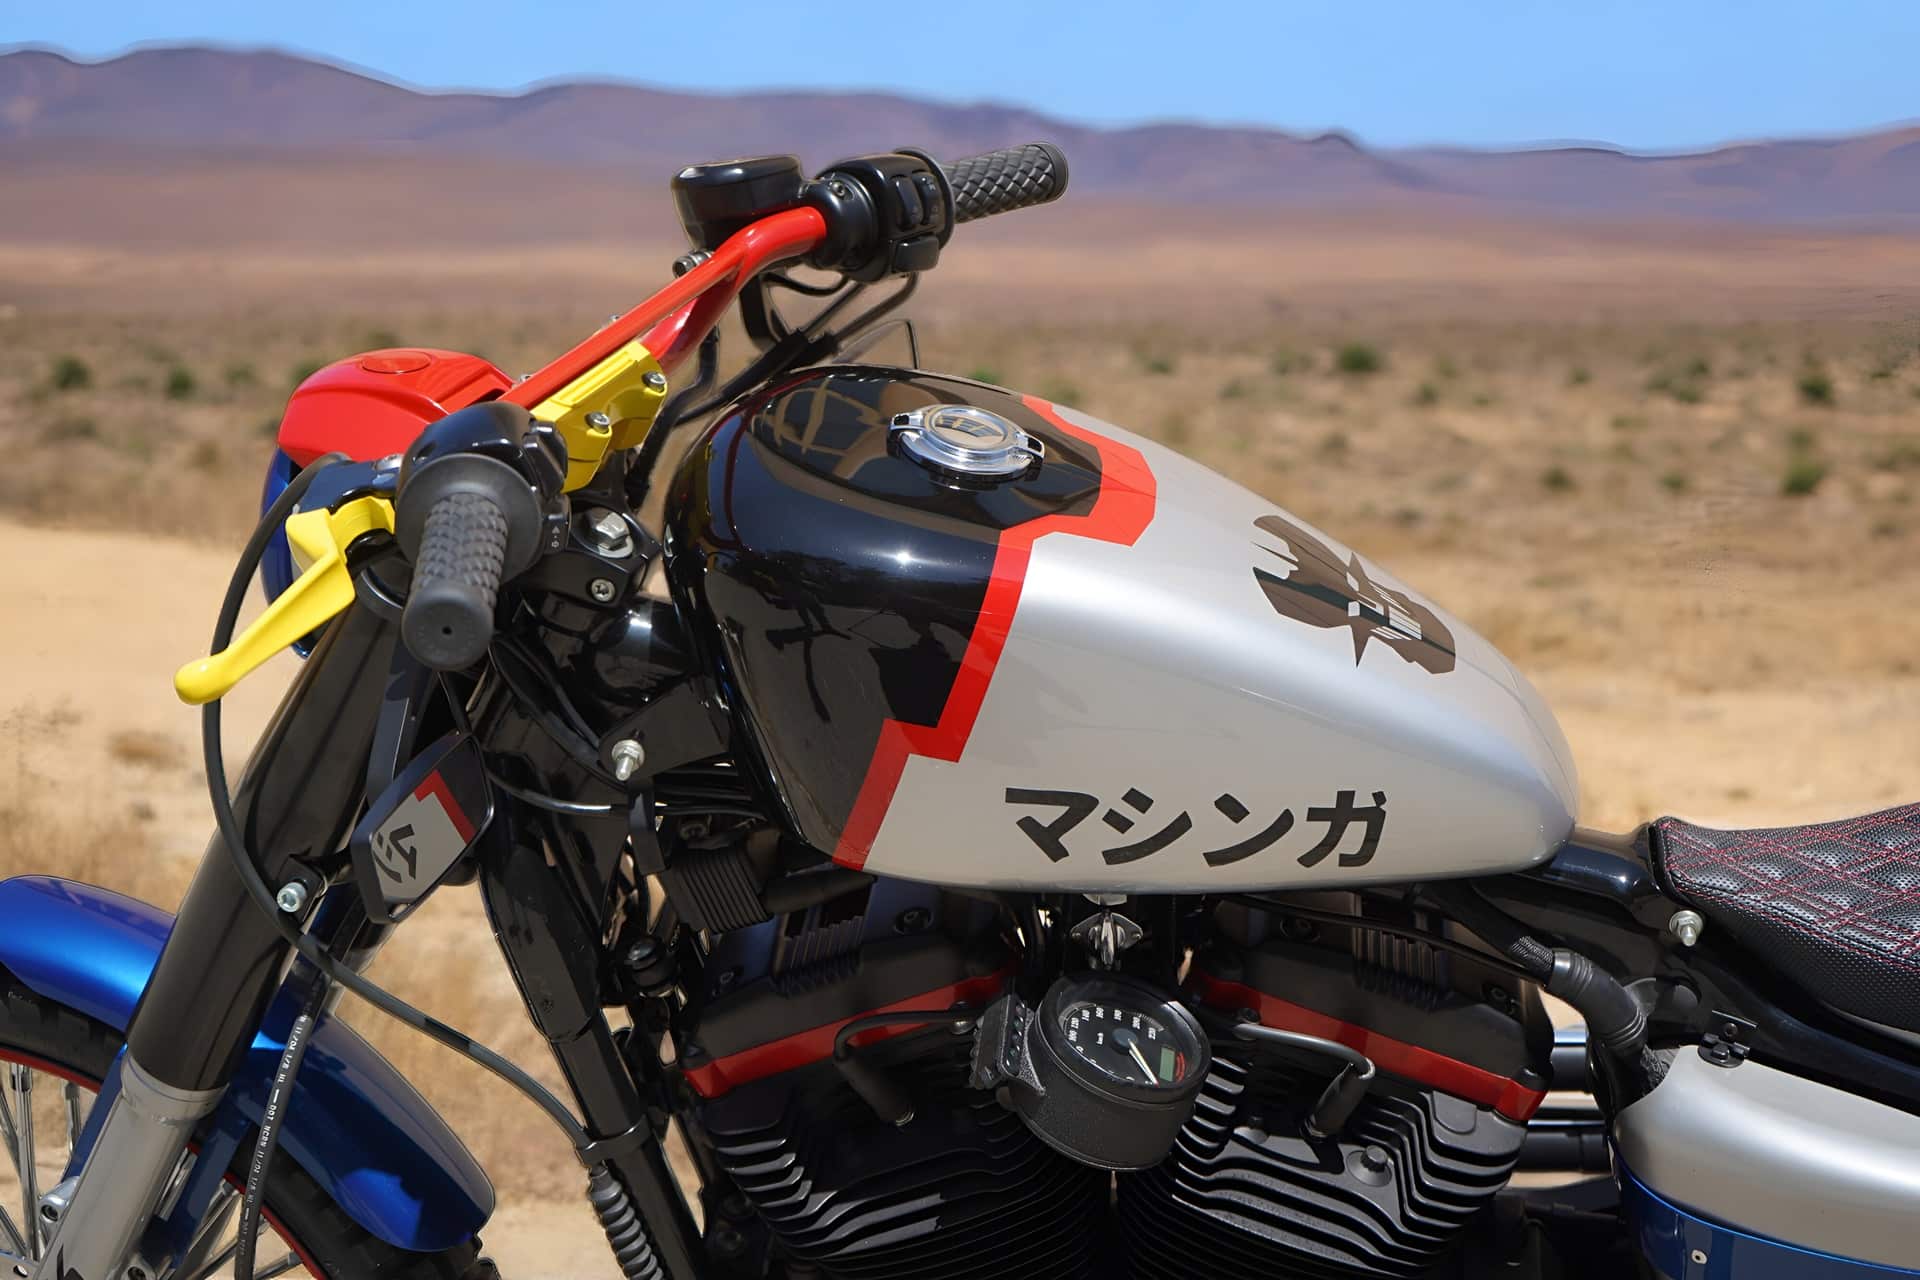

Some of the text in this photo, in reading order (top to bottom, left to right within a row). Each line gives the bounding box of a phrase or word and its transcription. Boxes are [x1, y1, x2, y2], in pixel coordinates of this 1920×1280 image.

[1005, 787, 1388, 868] マシンガ
[267, 1104, 277, 1121] DOT
